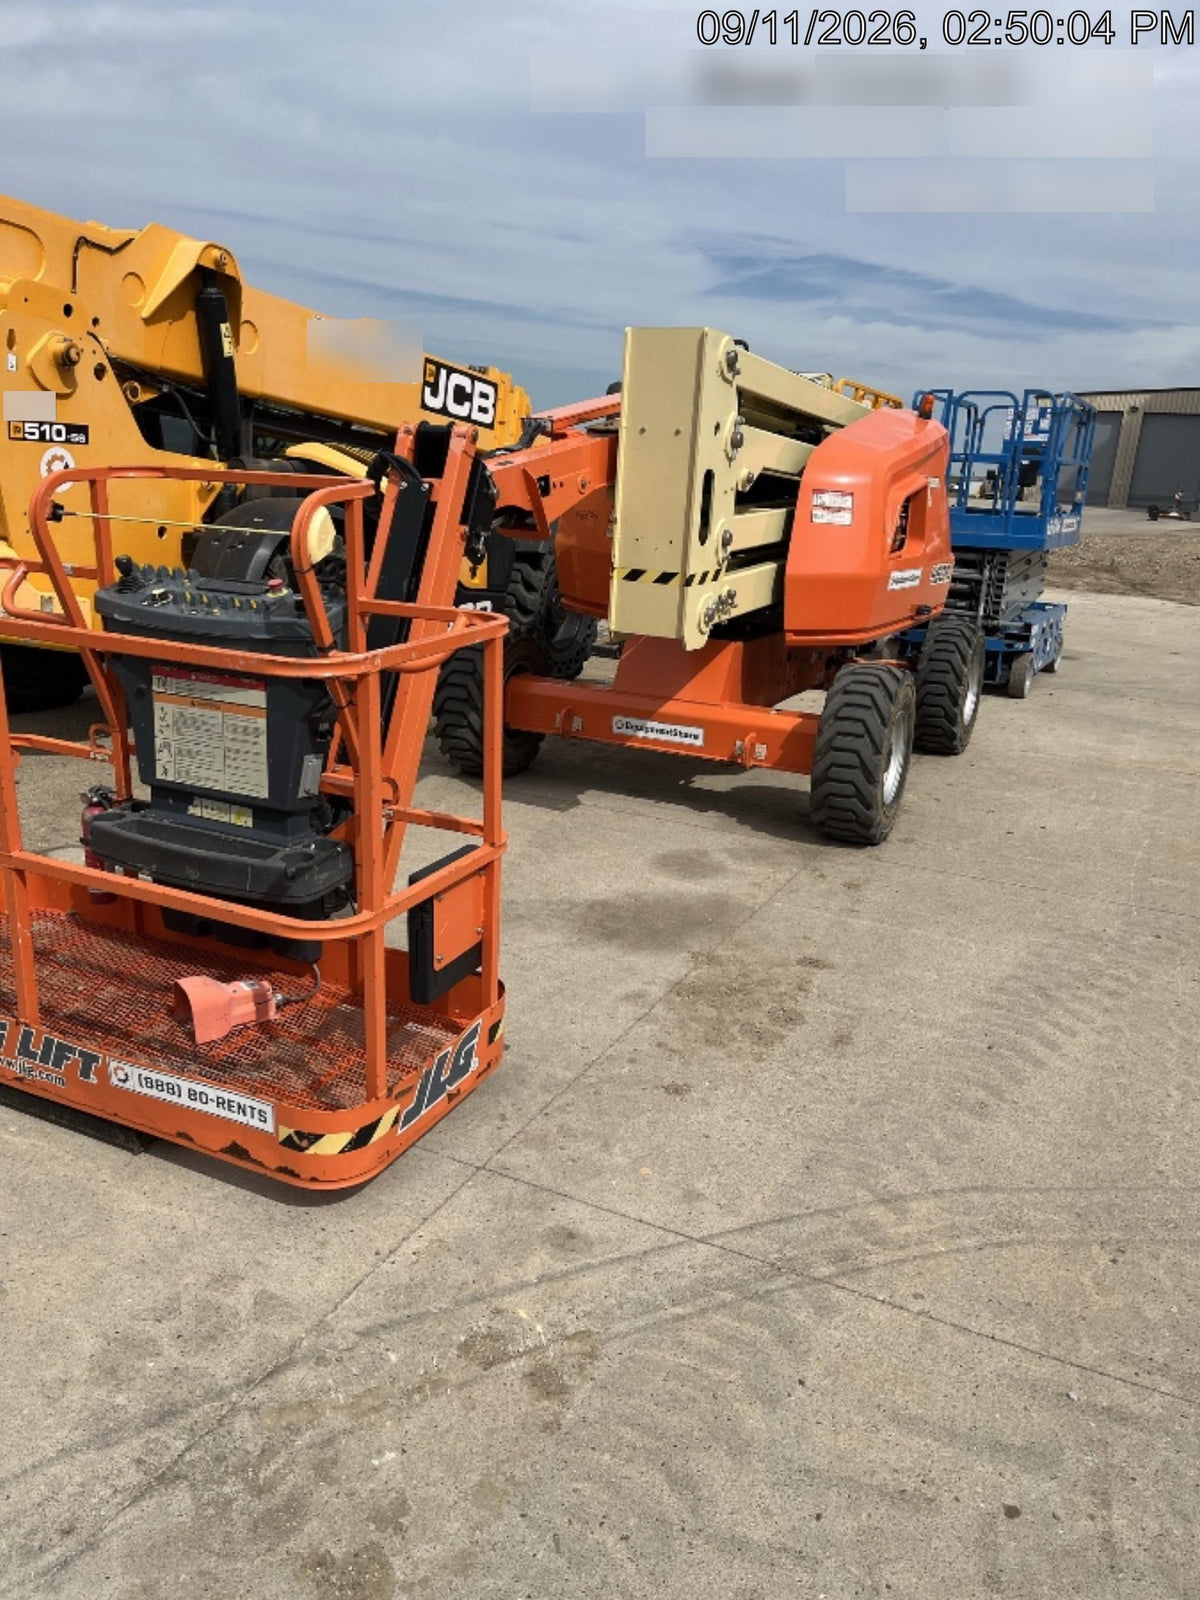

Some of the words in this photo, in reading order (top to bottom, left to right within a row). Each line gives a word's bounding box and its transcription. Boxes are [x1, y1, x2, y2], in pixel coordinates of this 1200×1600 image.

[423, 366, 496, 424] JCB
[16, 1026, 103, 1082] LIFT
[398, 1019, 482, 1134] JLG
[137, 1073, 182, 1098] (888)
